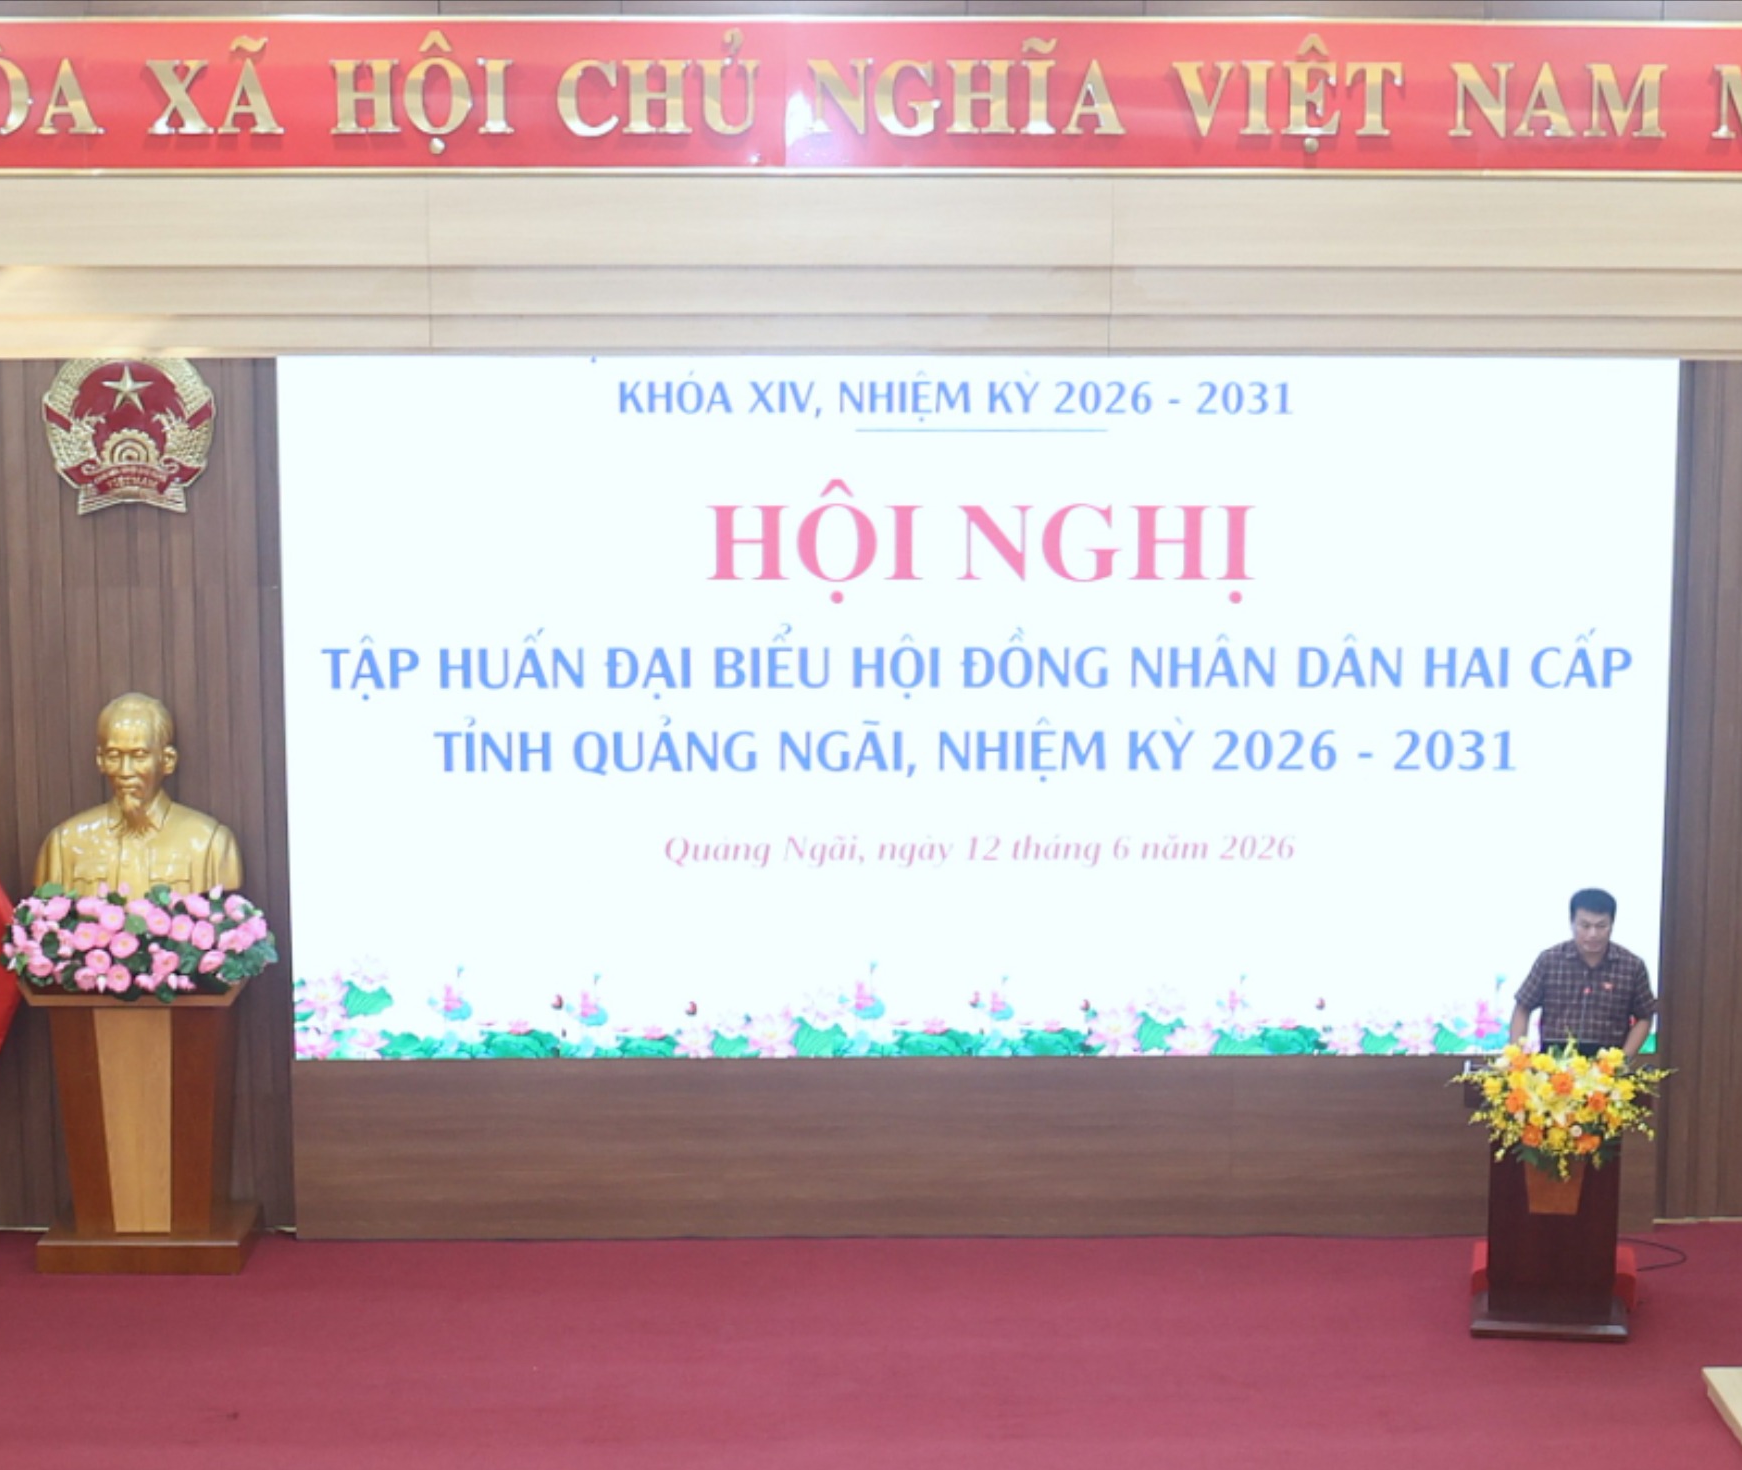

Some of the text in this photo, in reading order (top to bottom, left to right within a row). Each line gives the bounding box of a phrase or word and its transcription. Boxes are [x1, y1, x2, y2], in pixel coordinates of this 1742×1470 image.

[146, 38, 283, 138] XÃ
[331, 36, 513, 157] HỘI
[557, 27, 760, 140] CHỦ
[809, 37, 1125, 138] NGHĨA
[1171, 34, 1404, 155] VIỆT
[1451, 61, 1669, 138] NAM
[619, 372, 733, 414] KHÓA
[749, 381, 821, 418] XIV,
[840, 371, 971, 422] NHIỆM
[988, 381, 1039, 414] KỲ
[1054, 381, 1152, 415] 2026
[1197, 381, 1291, 415] 2031
[708, 478, 1254, 604] HỘI NGHỊ
[321, 623, 1632, 701] TẬP HUẤN ĐẠI BIỂU HỘI ĐỒNG NHÂN DÂN HAI CẤP
[433, 717, 552, 773] TỈNH
[573, 716, 757, 776] QUẢNG
[780, 720, 916, 778] NGÃI,
[939, 717, 1106, 782] NHIỆM
[1128, 717, 1194, 771] KỲ
[1212, 729, 1337, 771] 2026
[1394, 729, 1516, 771] 2031
